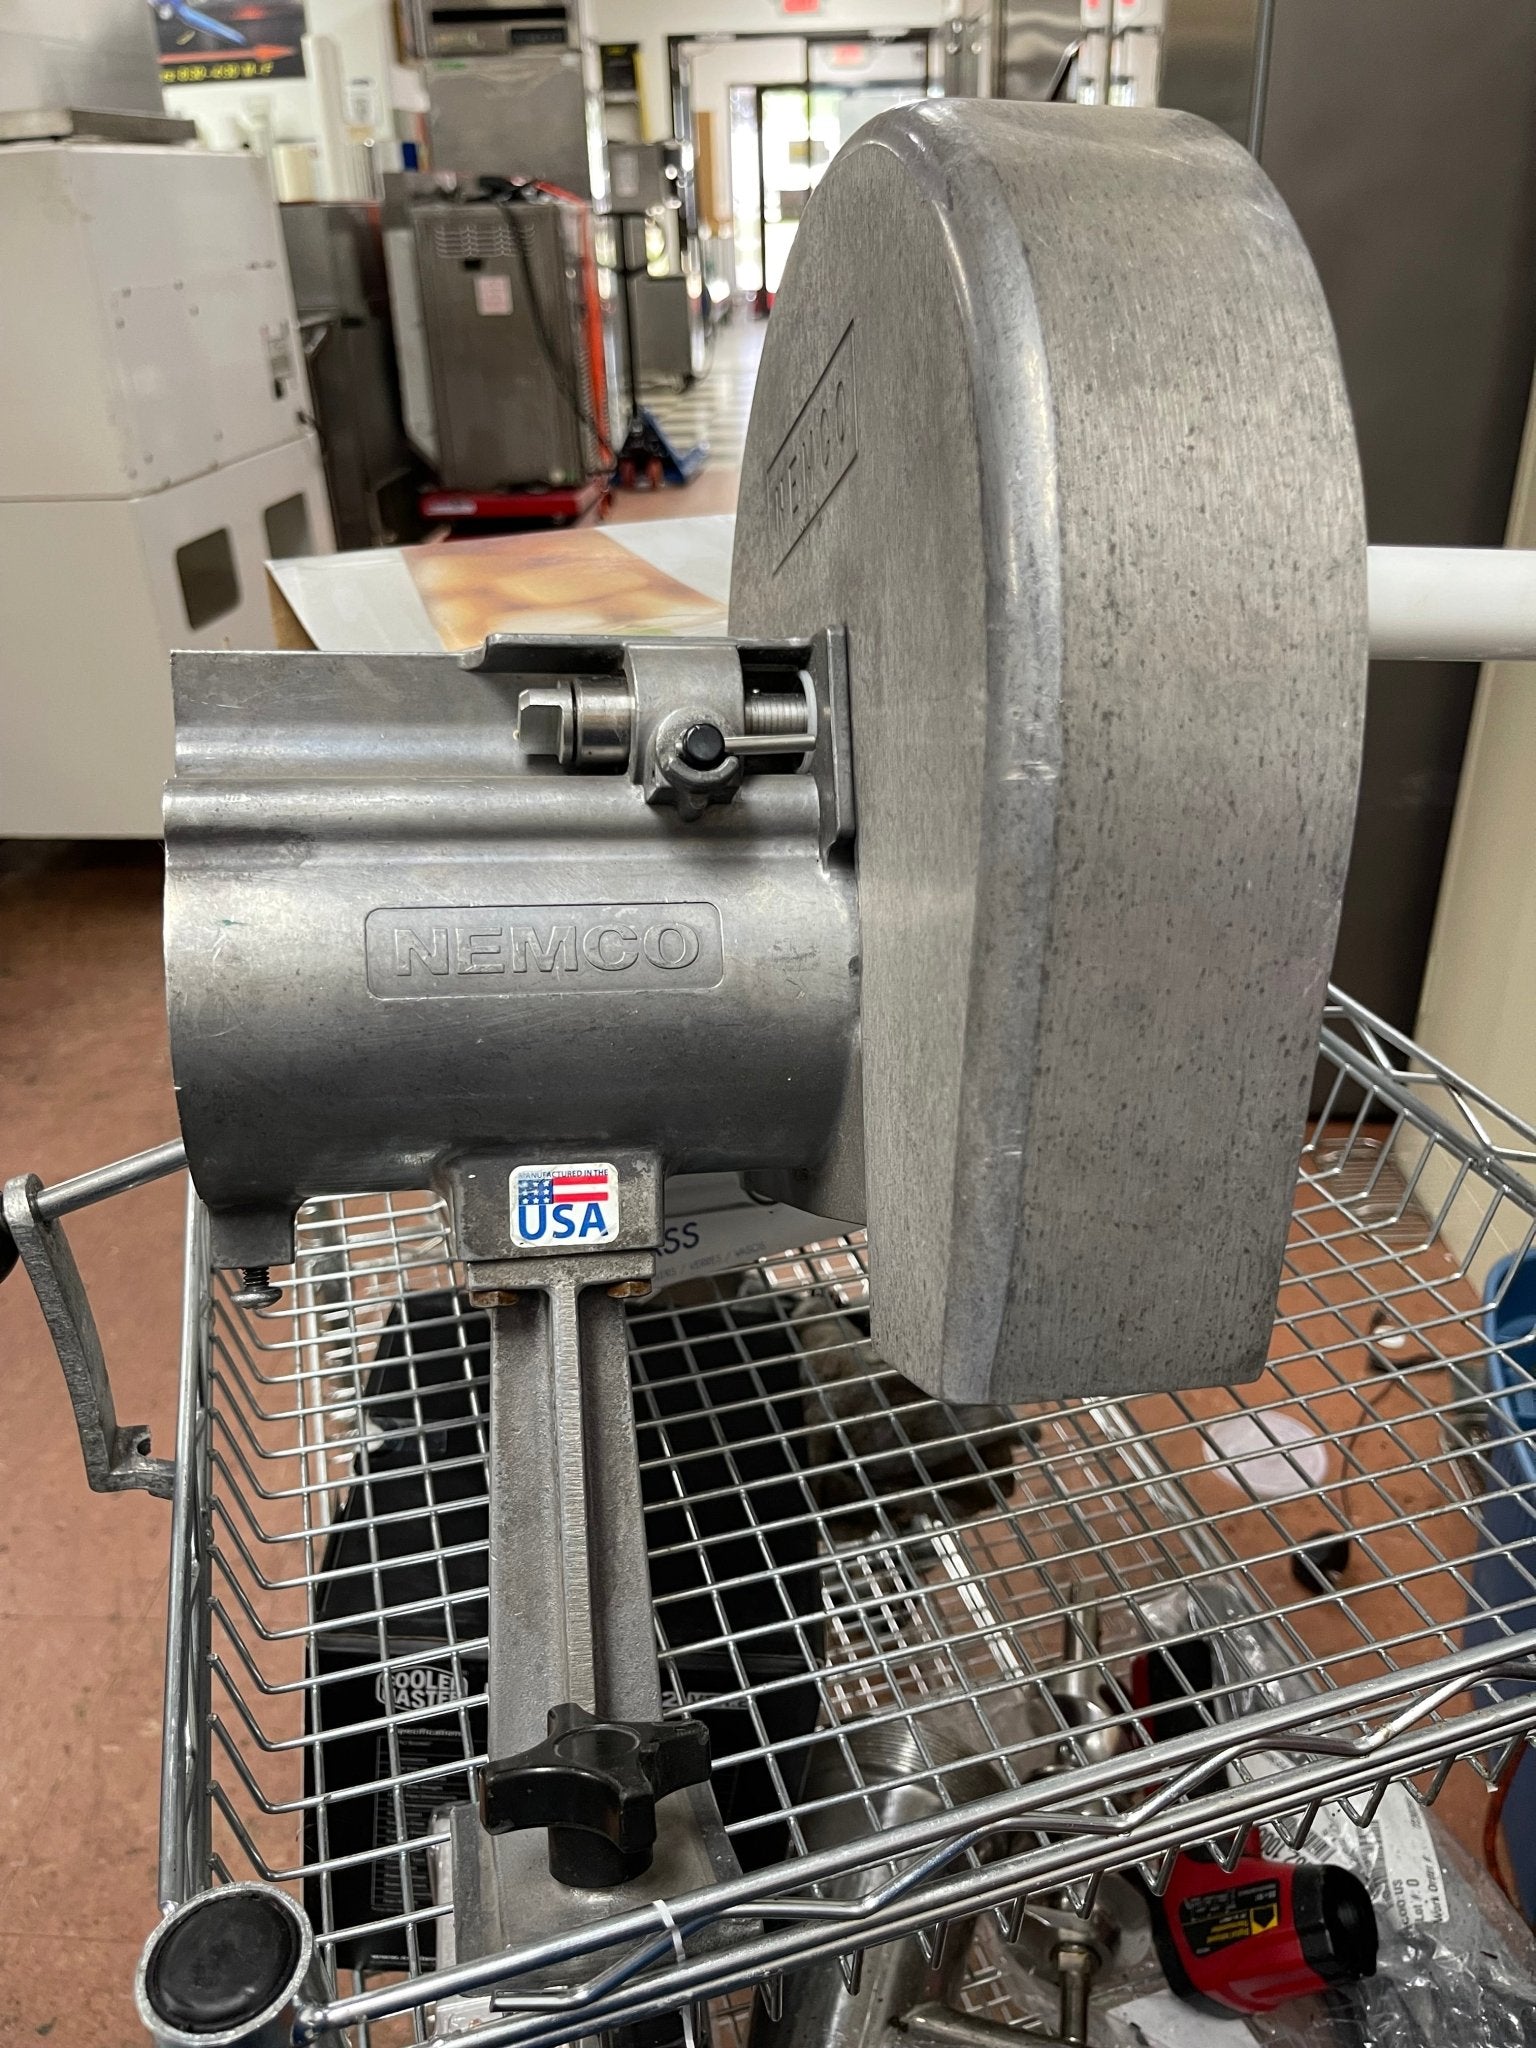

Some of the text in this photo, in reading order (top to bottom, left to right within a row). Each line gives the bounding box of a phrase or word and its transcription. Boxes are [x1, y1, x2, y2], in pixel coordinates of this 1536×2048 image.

[772, 379, 847, 536] NEMCO
[393, 921, 700, 977] NEMCO
[518, 1170, 582, 1179] MANUFACTURED
[518, 1203, 609, 1240] USA
